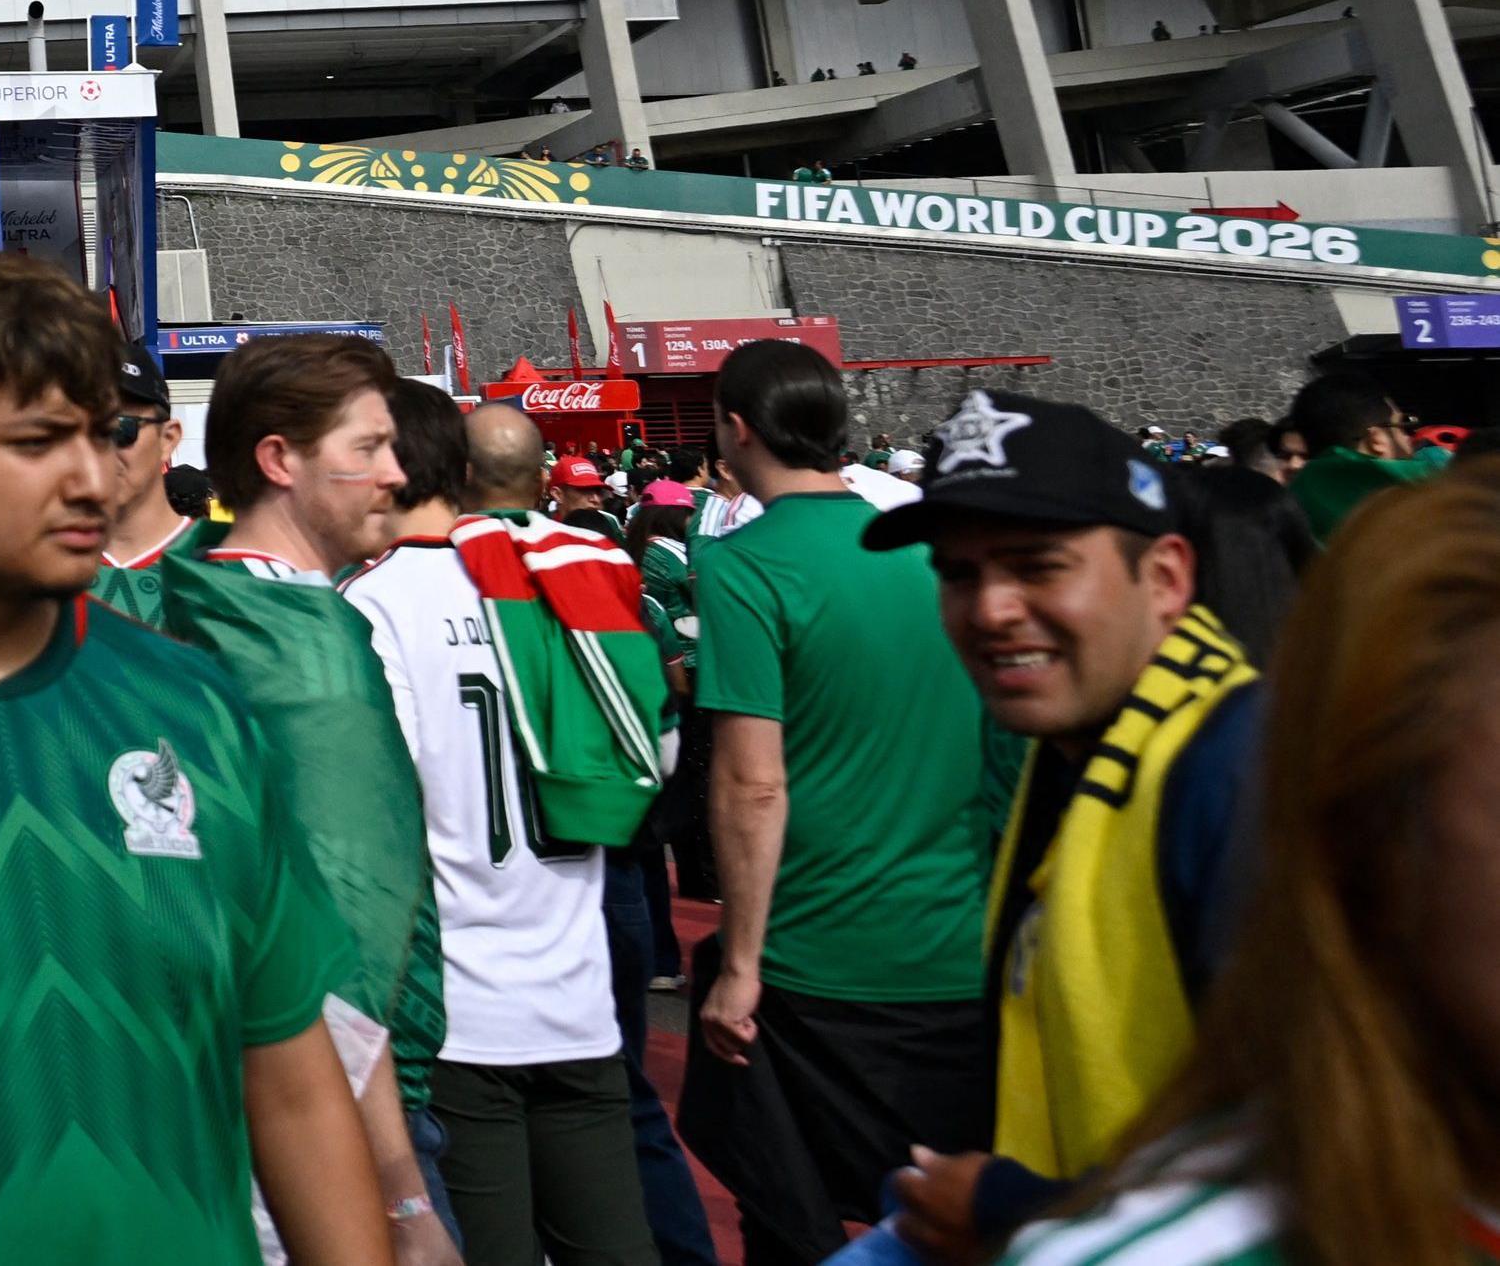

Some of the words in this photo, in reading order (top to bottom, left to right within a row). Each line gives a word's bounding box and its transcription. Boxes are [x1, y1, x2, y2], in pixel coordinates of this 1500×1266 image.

[106, 23, 115, 62] ULTRA
[755, 183, 865, 224] FIFA
[866, 189, 1056, 238] WORLD
[1064, 207, 1167, 249] CUP
[1176, 214, 1361, 265] 2026
[182, 335, 226, 346] ULTRA
[1414, 319, 1435, 342] 2
[631, 343, 646, 367] 1
